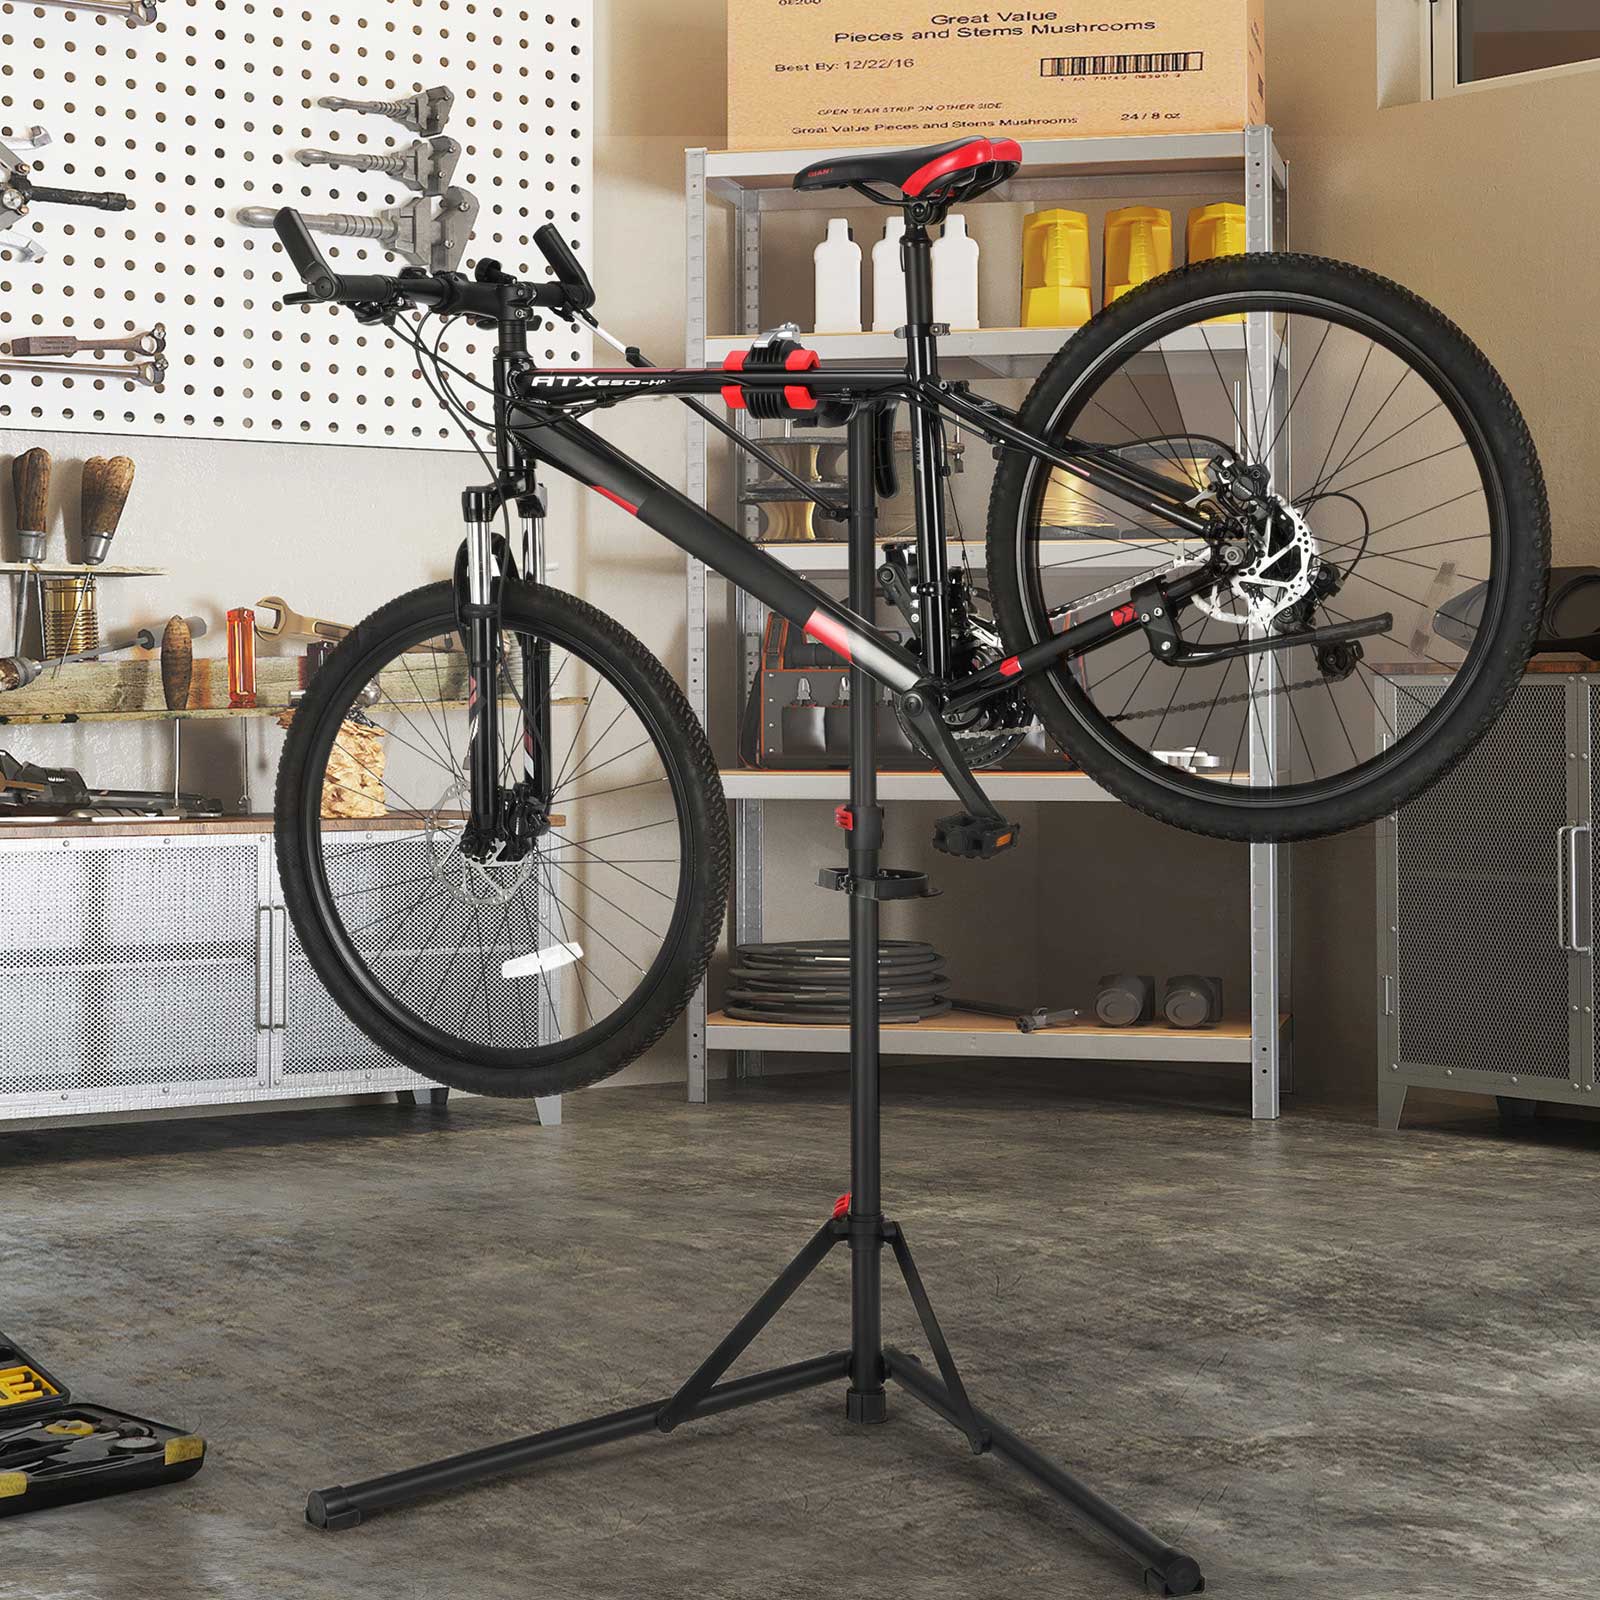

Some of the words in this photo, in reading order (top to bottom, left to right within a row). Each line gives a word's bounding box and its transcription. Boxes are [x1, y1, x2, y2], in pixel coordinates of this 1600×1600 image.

[930, 13, 990, 26] Great
[996, 10, 1058, 22] Value
[834, 32, 904, 43] Pieces
[911, 28, 950, 41] and
[956, 26, 1024, 38] Stems
[1030, 20, 1156, 35] Mushrooms
[774, 63, 810, 73] Best
[815, 62, 840, 73] By:
[843, 58, 915, 70] 12/22/16
[817, 108, 849, 116] OPEN
[852, 107, 880, 115] TEAR
[882, 105, 915, 113] STRIP
[918, 105, 934, 113] ON
[935, 103, 976, 112] OTHER
[977, 102, 1003, 110] SIDE
[1120, 113, 1139, 122] 24
[1163, 112, 1182, 120] oz
[791, 126, 828, 135] Great
[831, 125, 871, 133] Value
[874, 123, 920, 132] Pieces
[922, 121, 949, 130] and
[951, 120, 996, 129] Stems
[998, 117, 1079, 127] Mushrooms
